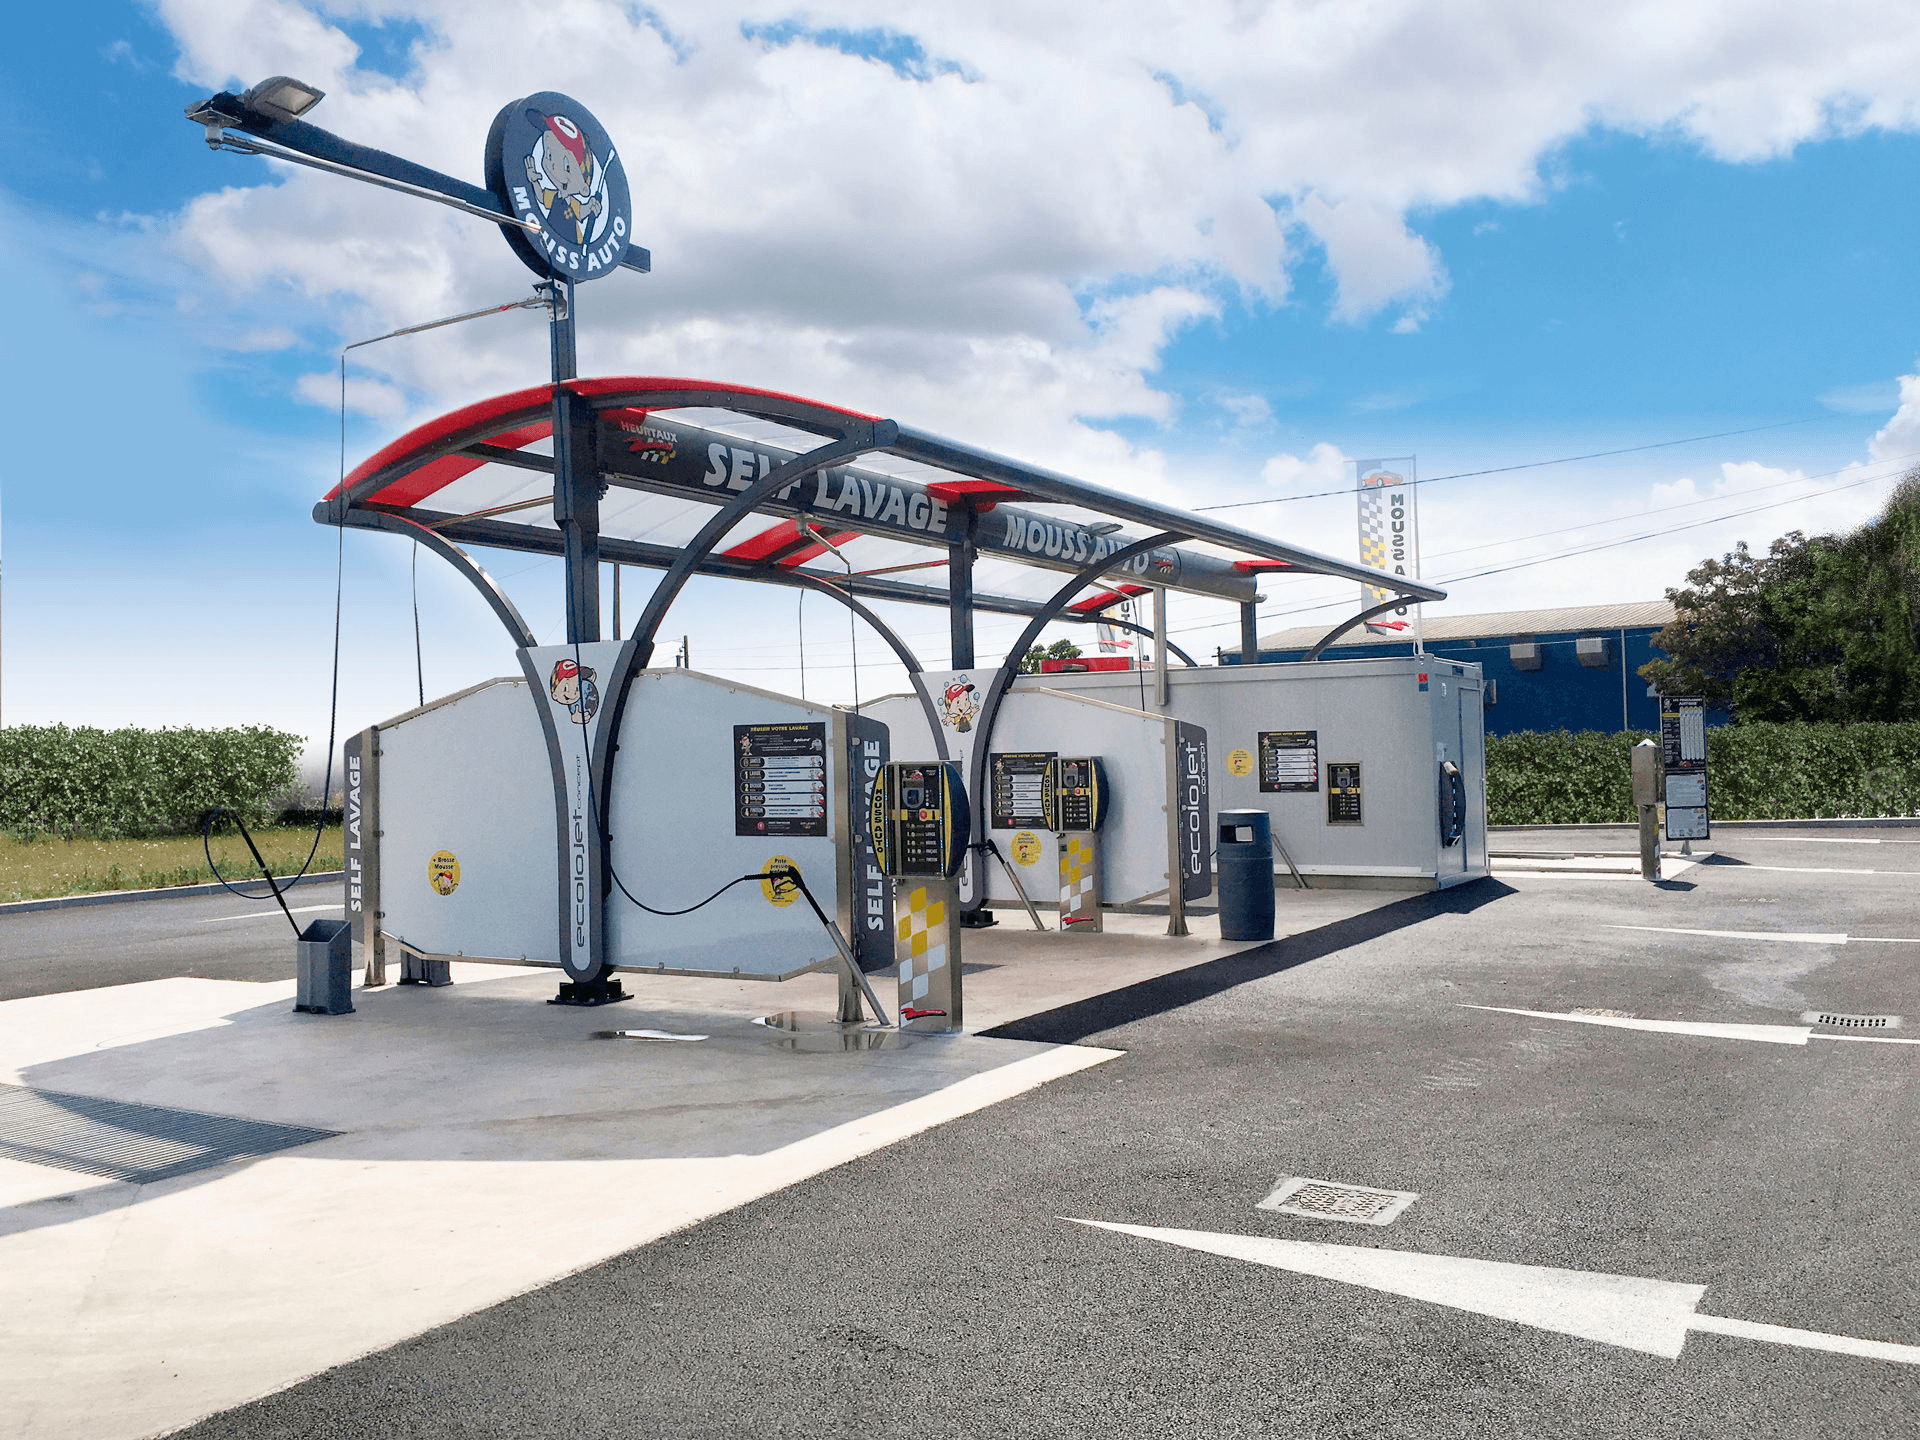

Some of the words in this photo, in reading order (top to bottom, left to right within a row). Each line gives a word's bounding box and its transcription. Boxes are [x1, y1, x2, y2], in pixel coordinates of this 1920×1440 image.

[620, 420, 678, 443] HEURTAUX
[812, 469, 949, 534] LAVAGE
[349, 755, 361, 850] LAVAGE
[874, 788, 883, 823] MOUSS
[1185, 741, 1201, 875] ecolojet
[874, 825, 884, 853] AUTO
[350, 857, 362, 912] SELF
[572, 809, 585, 948] ecolojet
[866, 864, 884, 931] SELF
